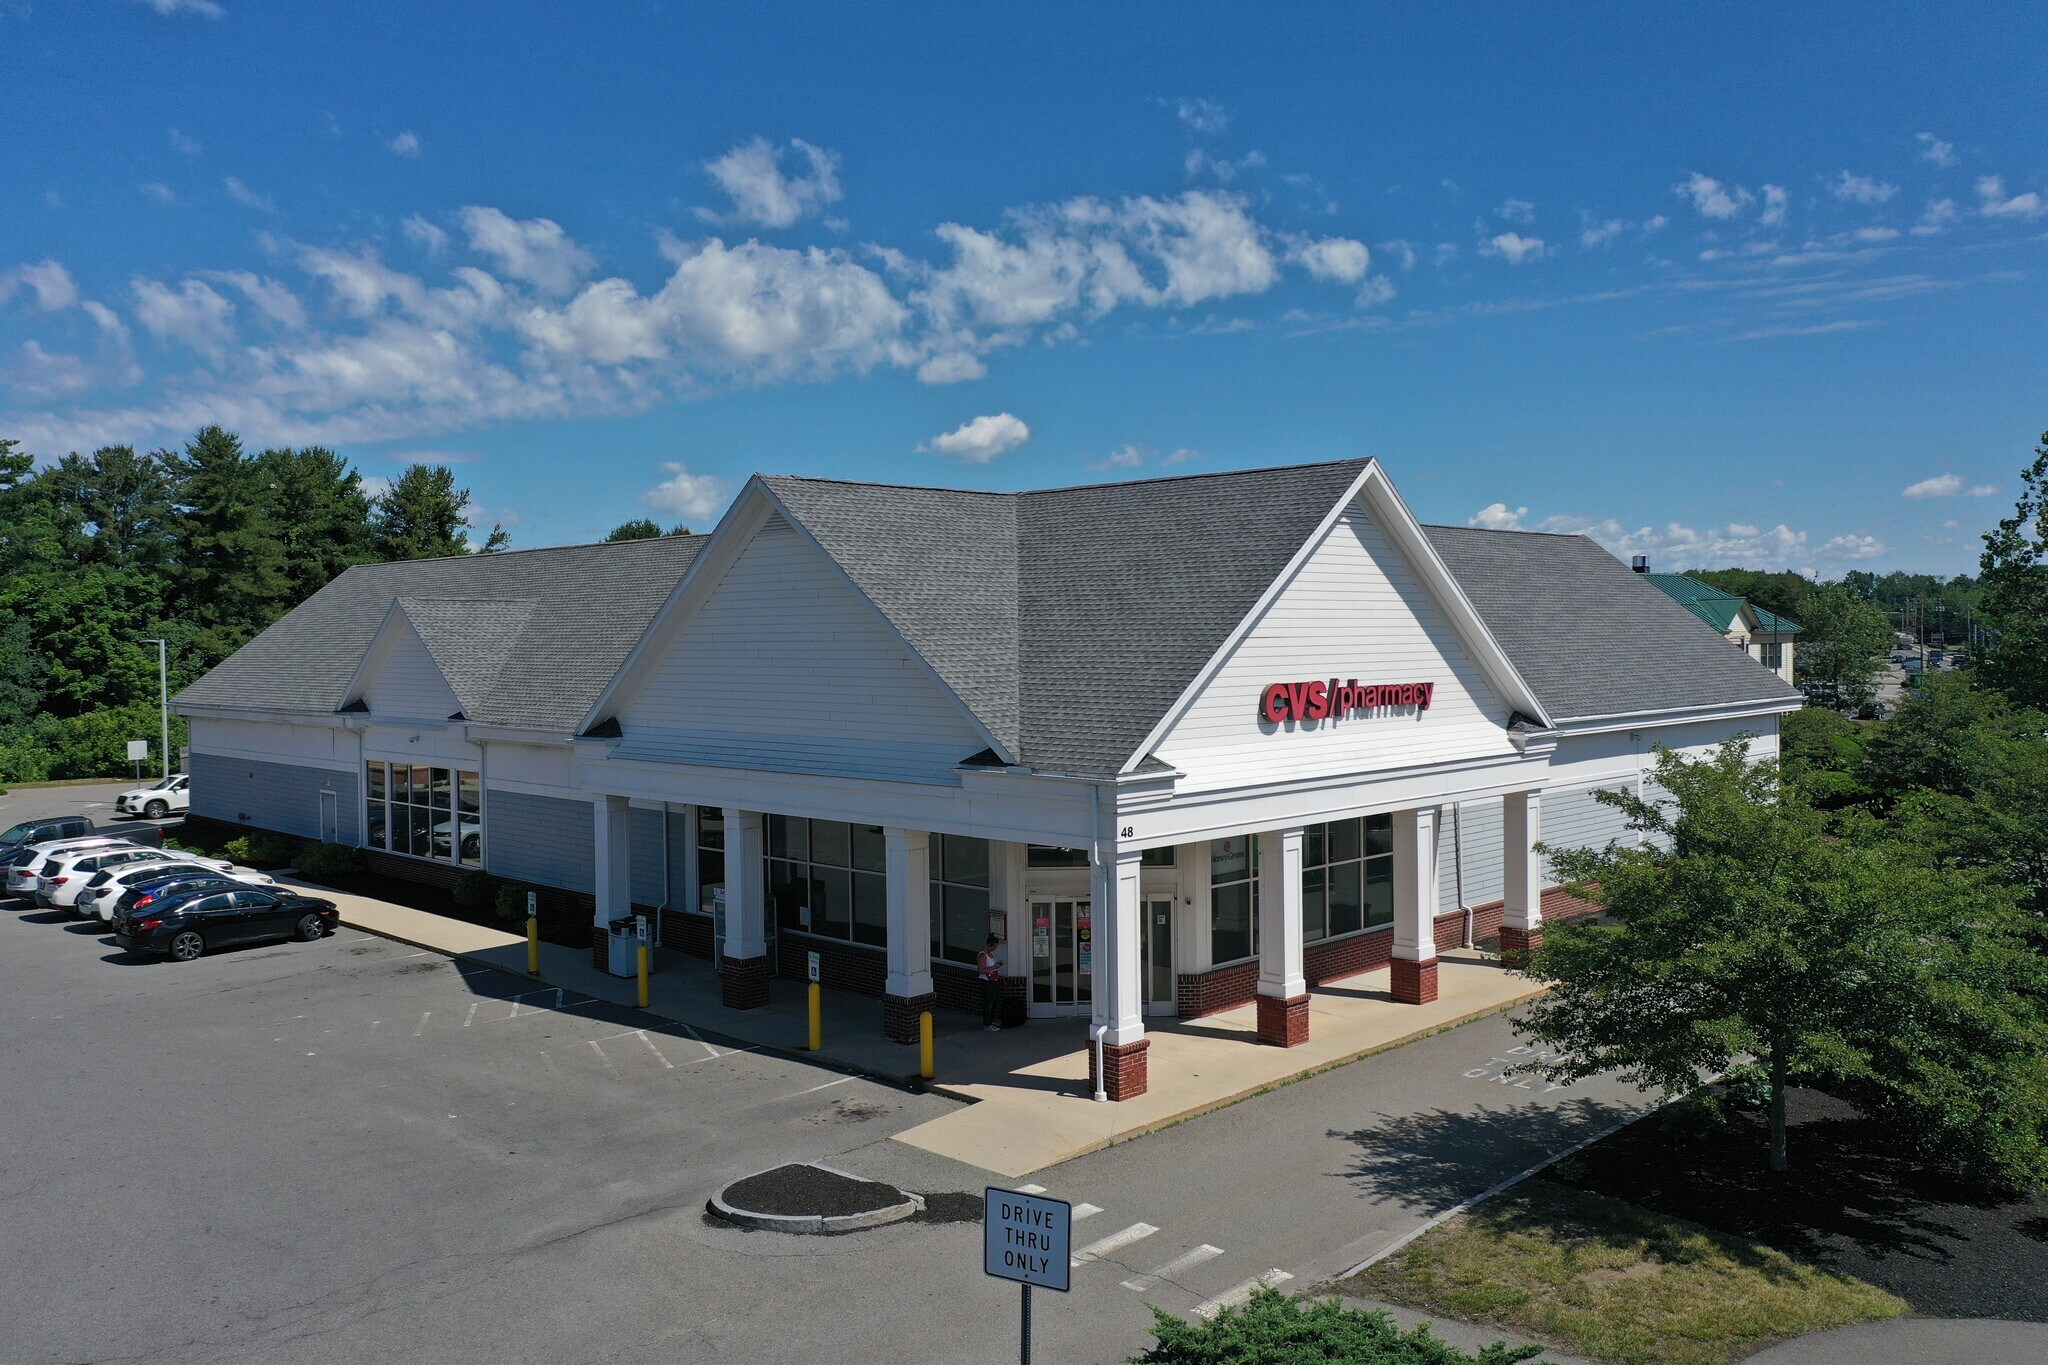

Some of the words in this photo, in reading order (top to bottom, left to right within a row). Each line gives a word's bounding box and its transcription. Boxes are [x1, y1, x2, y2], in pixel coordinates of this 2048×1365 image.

[1261, 678, 1434, 723] CVS/pharmacy
[1120, 826, 1134, 838] 48
[1001, 1203, 1053, 1229] DRIVE
[1005, 1226, 1050, 1251] THRU
[1004, 1250, 1049, 1274] ONLY
